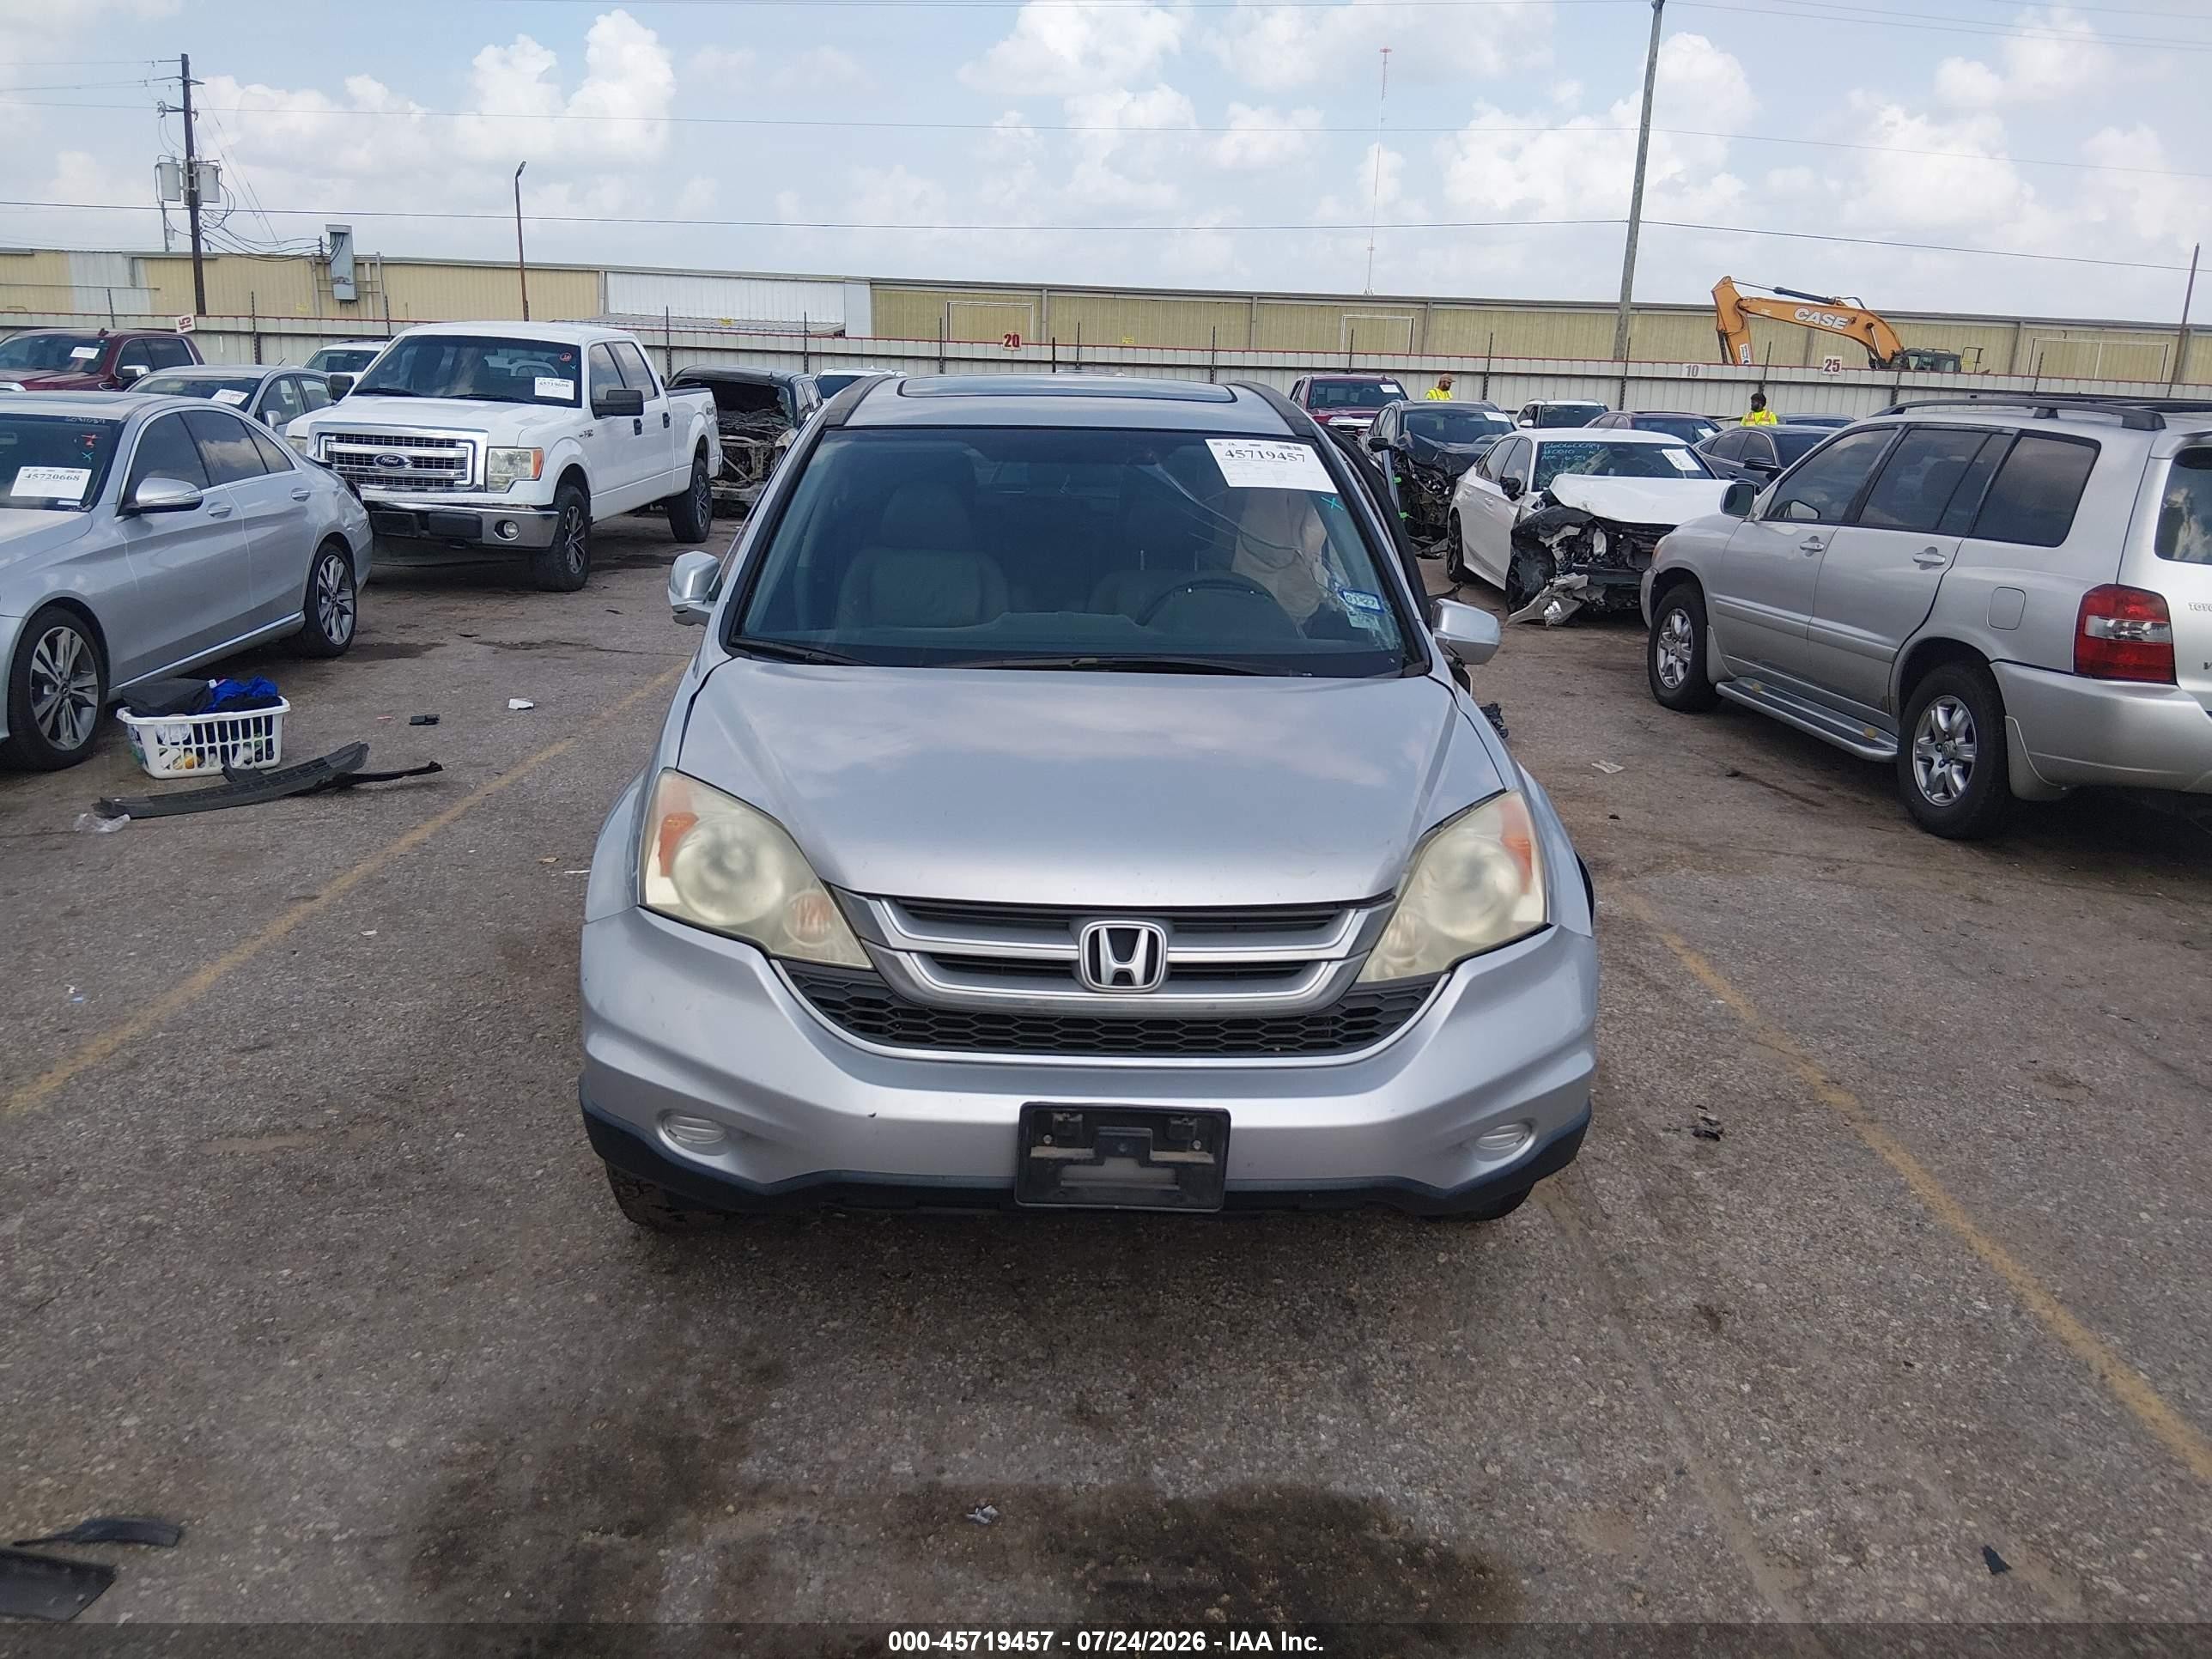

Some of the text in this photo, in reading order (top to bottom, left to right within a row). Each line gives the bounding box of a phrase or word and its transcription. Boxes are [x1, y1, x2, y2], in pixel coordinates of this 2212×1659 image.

[178, 316, 193, 331] 15
[1794, 307, 1849, 330] CASE
[1004, 333, 1020, 348] 20
[1686, 364, 1699, 378] 10
[1823, 358, 1841, 373] 25
[380, 456, 400, 465] Ford
[1224, 449, 1305, 463] 45719457
[24, 472, 81, 482] 45720668
